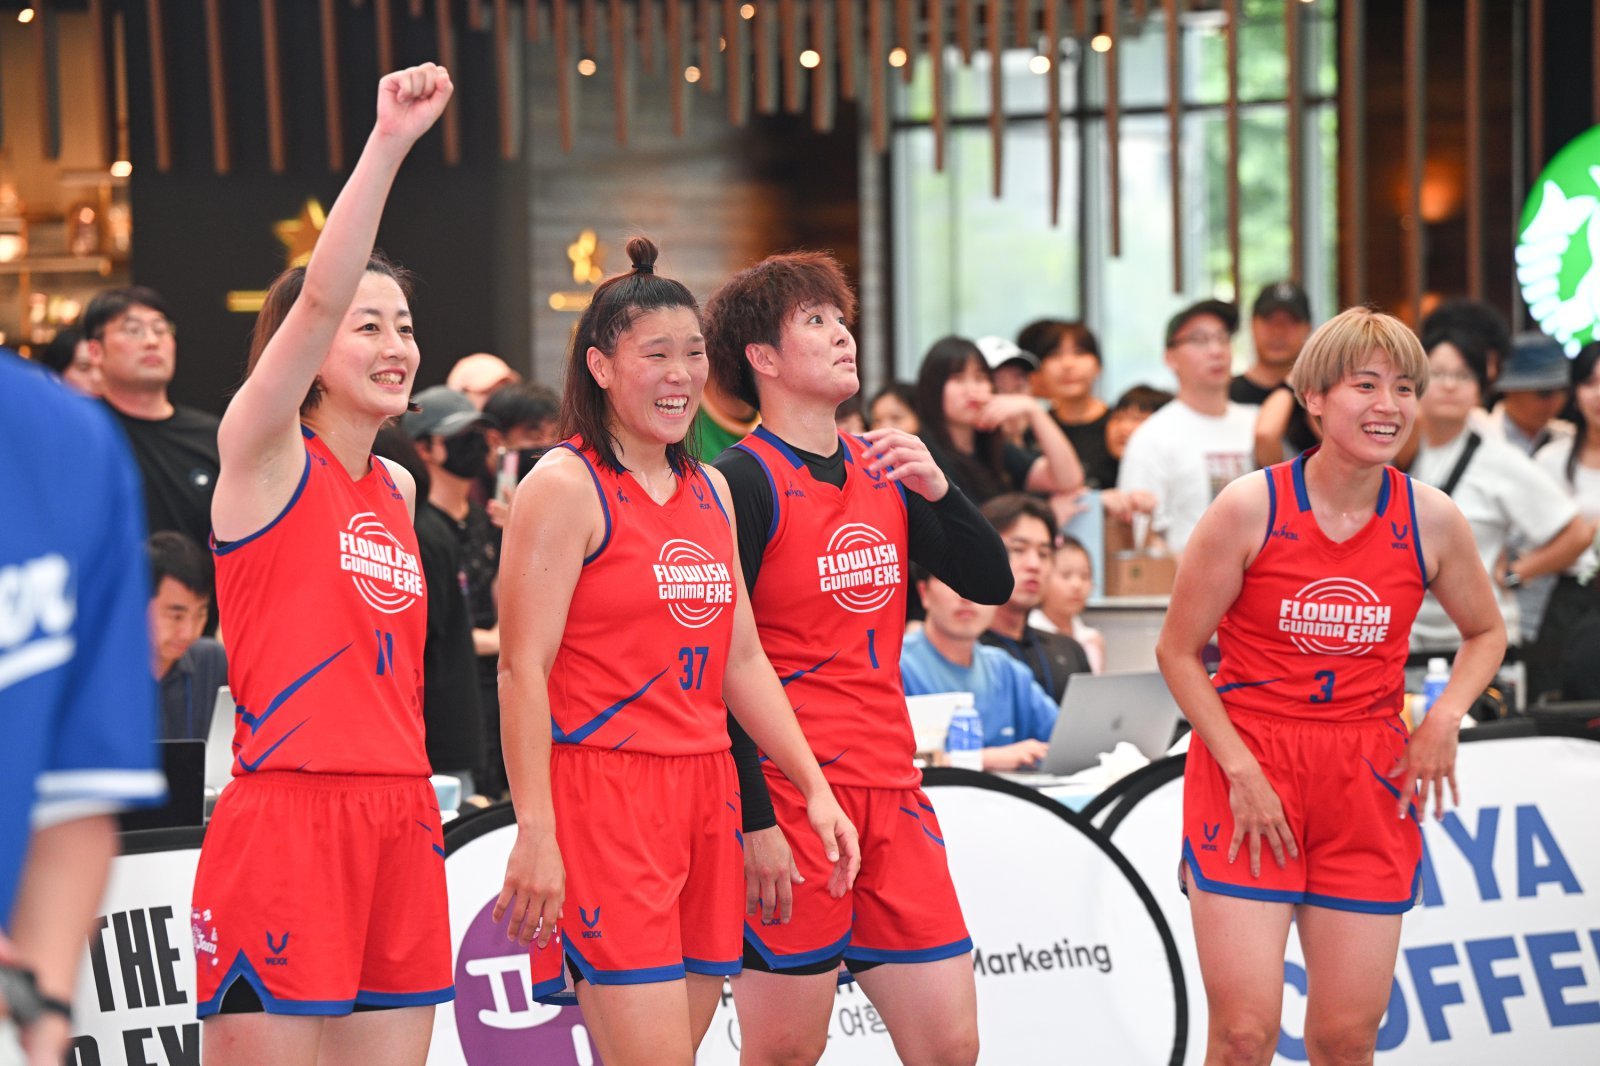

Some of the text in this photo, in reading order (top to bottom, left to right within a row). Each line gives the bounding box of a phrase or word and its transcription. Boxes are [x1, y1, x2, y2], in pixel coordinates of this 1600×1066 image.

[339, 531, 419, 575] FLOWLISH
[652, 562, 731, 583] FLOWLISH
[816, 543, 899, 577] FLOWLISH
[1279, 598, 1392, 625] FLOWLISH
[375, 629, 394, 677] 11
[678, 646, 710, 691] 37
[866, 629, 880, 670] 1
[1309, 670, 1336, 703] 3
[88, 905, 188, 1013] THE
[1275, 929, 1600, 1061] CFFE
